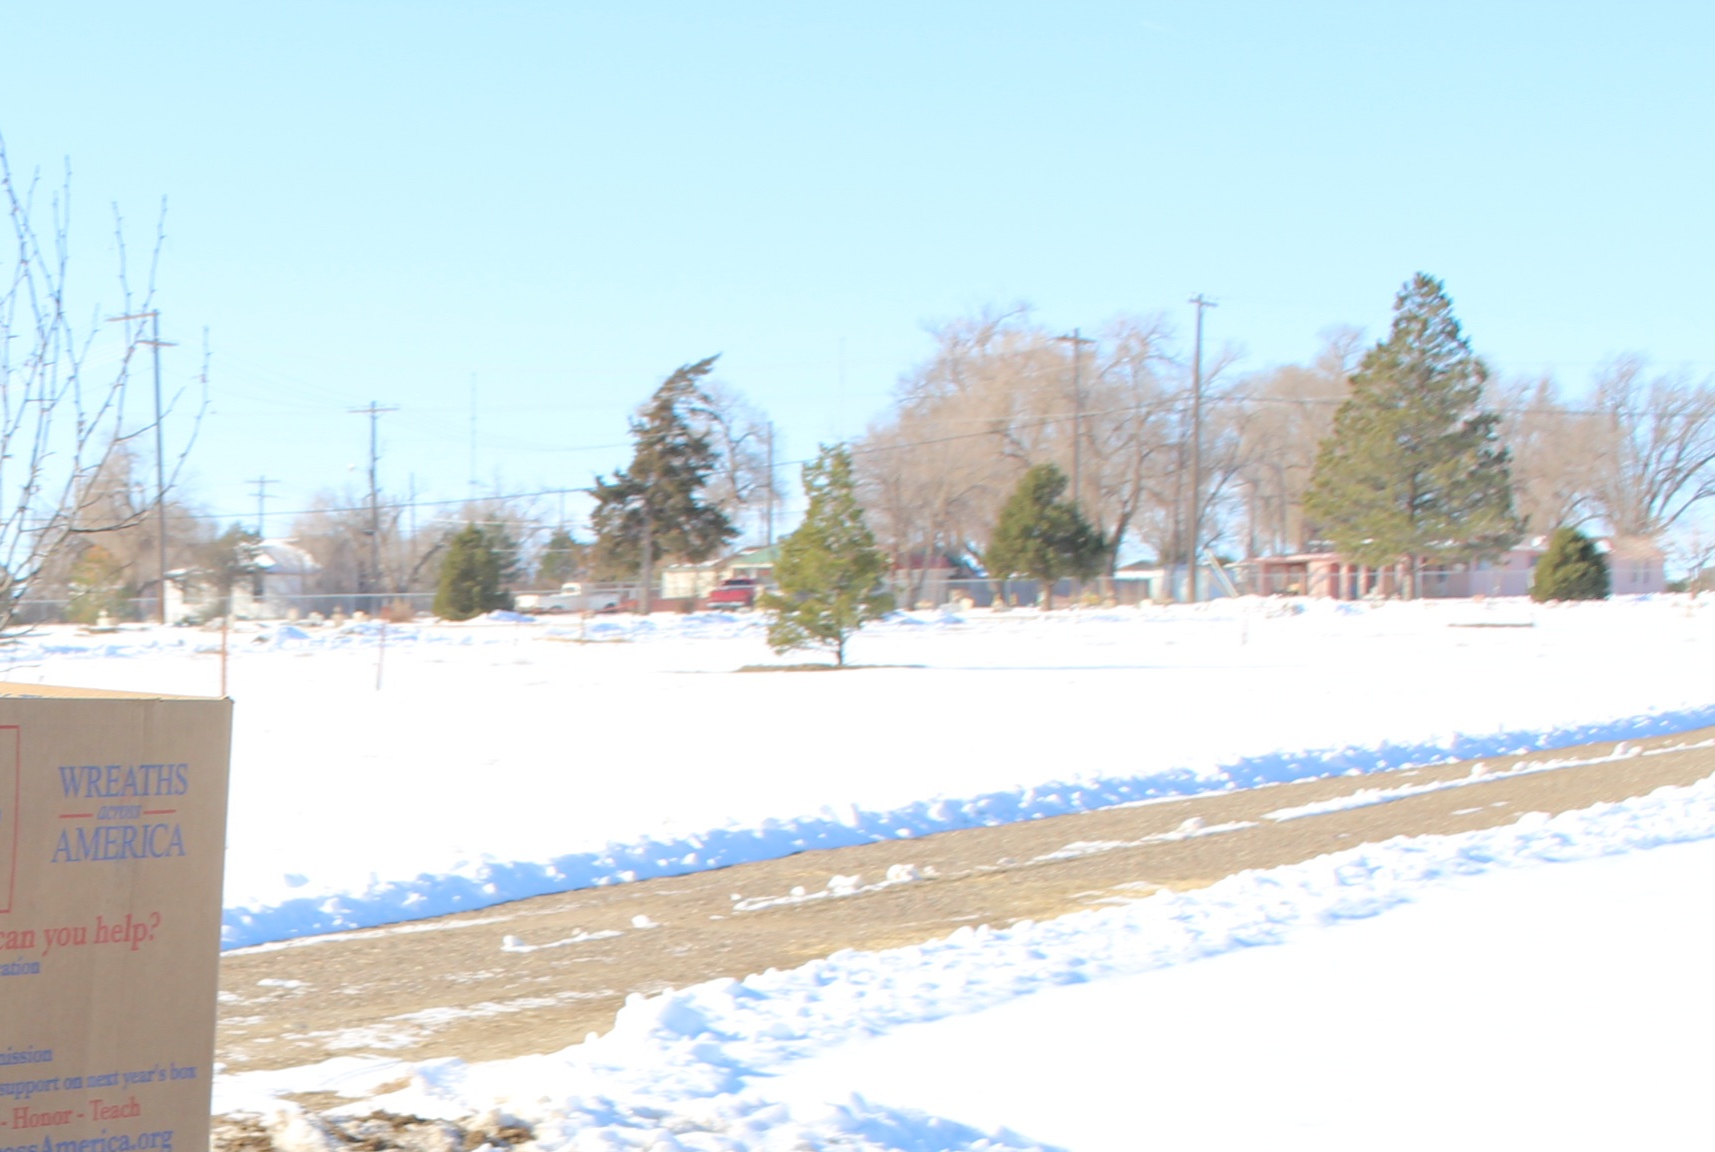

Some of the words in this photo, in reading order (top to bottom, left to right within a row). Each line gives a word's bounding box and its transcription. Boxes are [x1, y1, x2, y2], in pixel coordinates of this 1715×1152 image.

[58, 763, 189, 799] WREATHS
[97, 805, 142, 820] across
[50, 823, 187, 863] AMERICA
[42, 926, 87, 957] you
[93, 911, 162, 951] help?
[64, 1076, 82, 1090] on
[86, 1072, 120, 1088] next
[121, 1064, 167, 1090] year's
[170, 1063, 197, 1081] box
[11, 1106, 73, 1130] Honor
[89, 1096, 141, 1122] Teach
